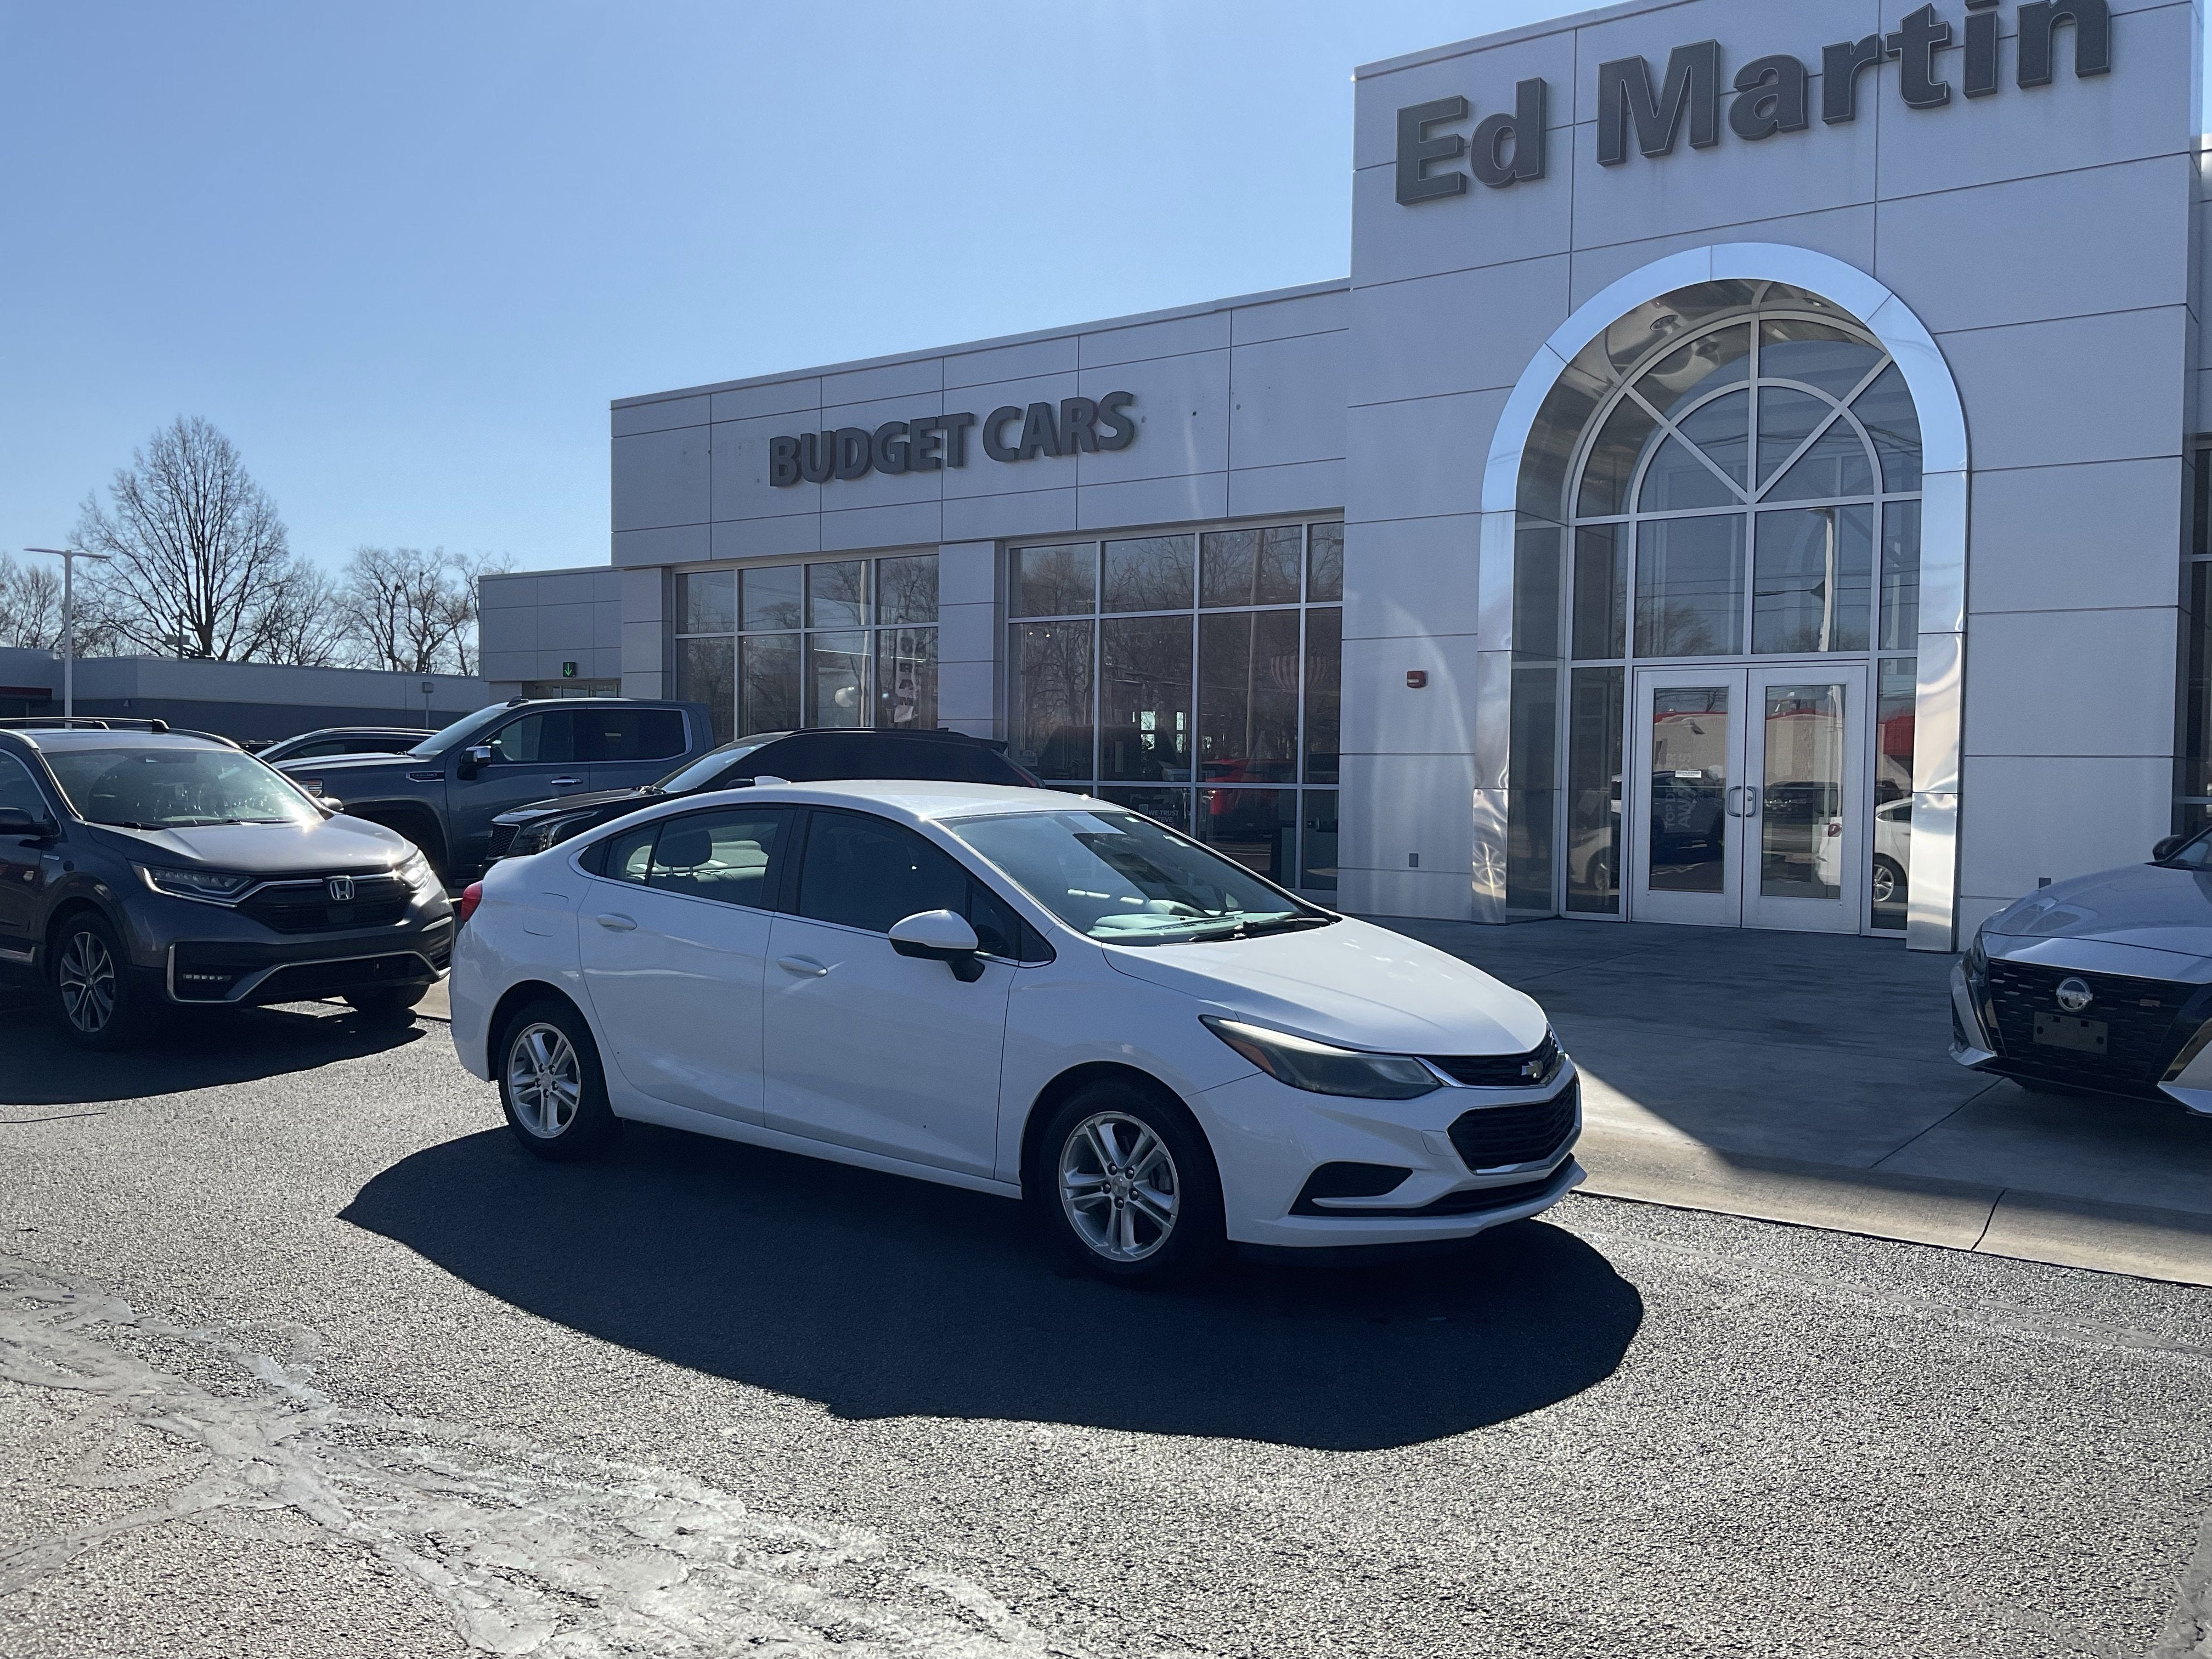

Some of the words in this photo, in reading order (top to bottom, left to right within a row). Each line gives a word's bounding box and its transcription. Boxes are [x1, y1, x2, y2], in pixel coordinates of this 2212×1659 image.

[1396, 77, 1547, 206] Ed
[1596, 0, 2112, 167] Martin
[770, 413, 974, 487] BUDGET
[983, 391, 1134, 462] CARS
